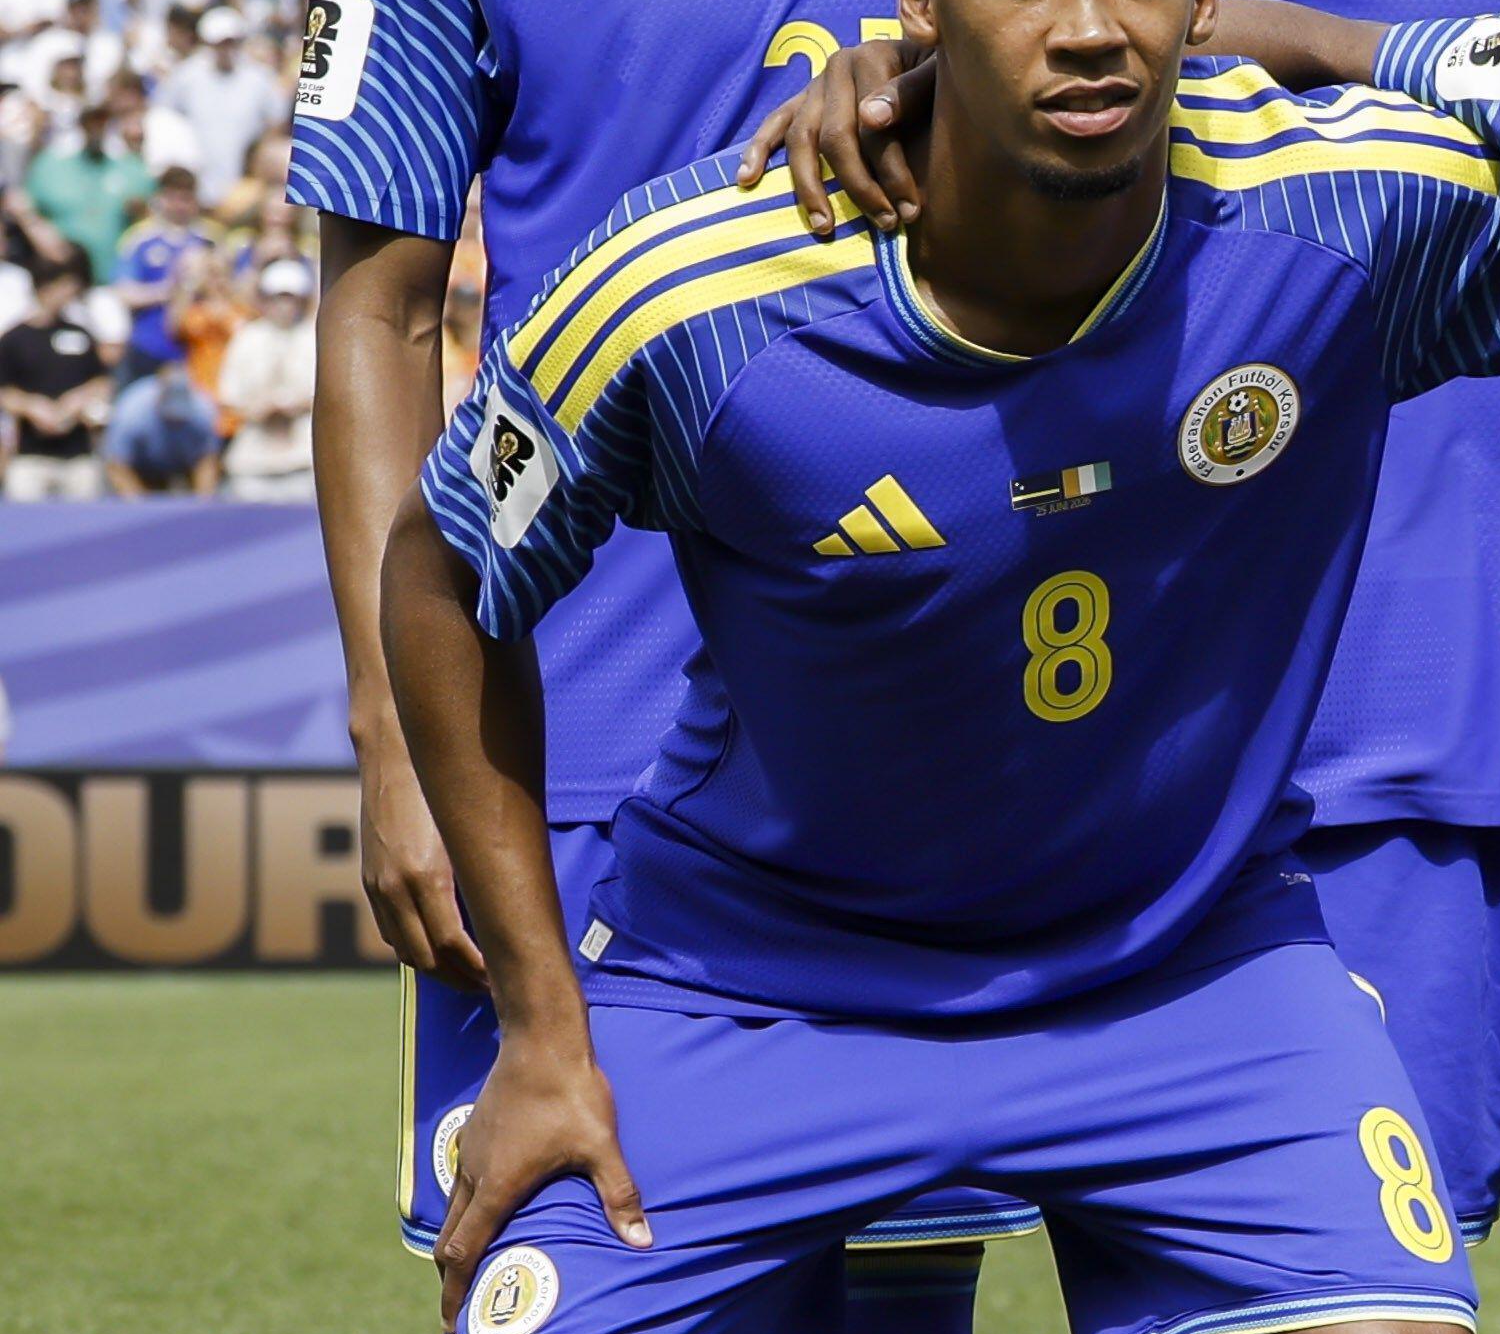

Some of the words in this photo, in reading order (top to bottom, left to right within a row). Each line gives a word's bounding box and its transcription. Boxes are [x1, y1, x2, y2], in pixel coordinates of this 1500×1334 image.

[1184, 387, 1223, 479] Federashon
[1022, 569, 1113, 723] 8
[438, 1115, 461, 1186] ederashon
[1357, 1105, 1456, 1265] 8
